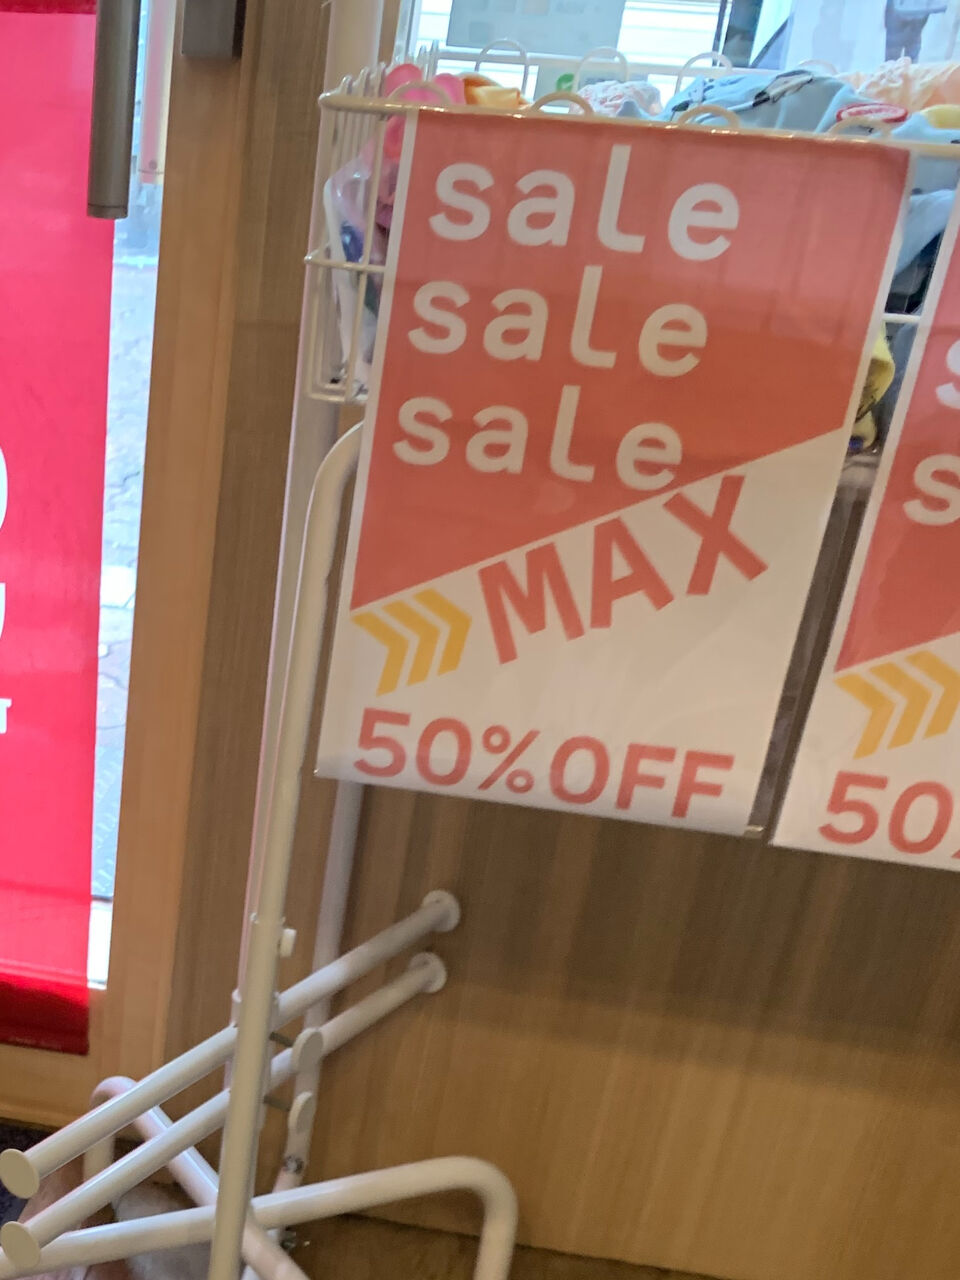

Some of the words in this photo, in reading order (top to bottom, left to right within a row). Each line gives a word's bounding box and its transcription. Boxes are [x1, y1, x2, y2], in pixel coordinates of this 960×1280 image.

[428, 144, 741, 261] sale
[407, 265, 709, 377] sale
[392, 385, 684, 490] sale
[477, 475, 769, 664] MAX
